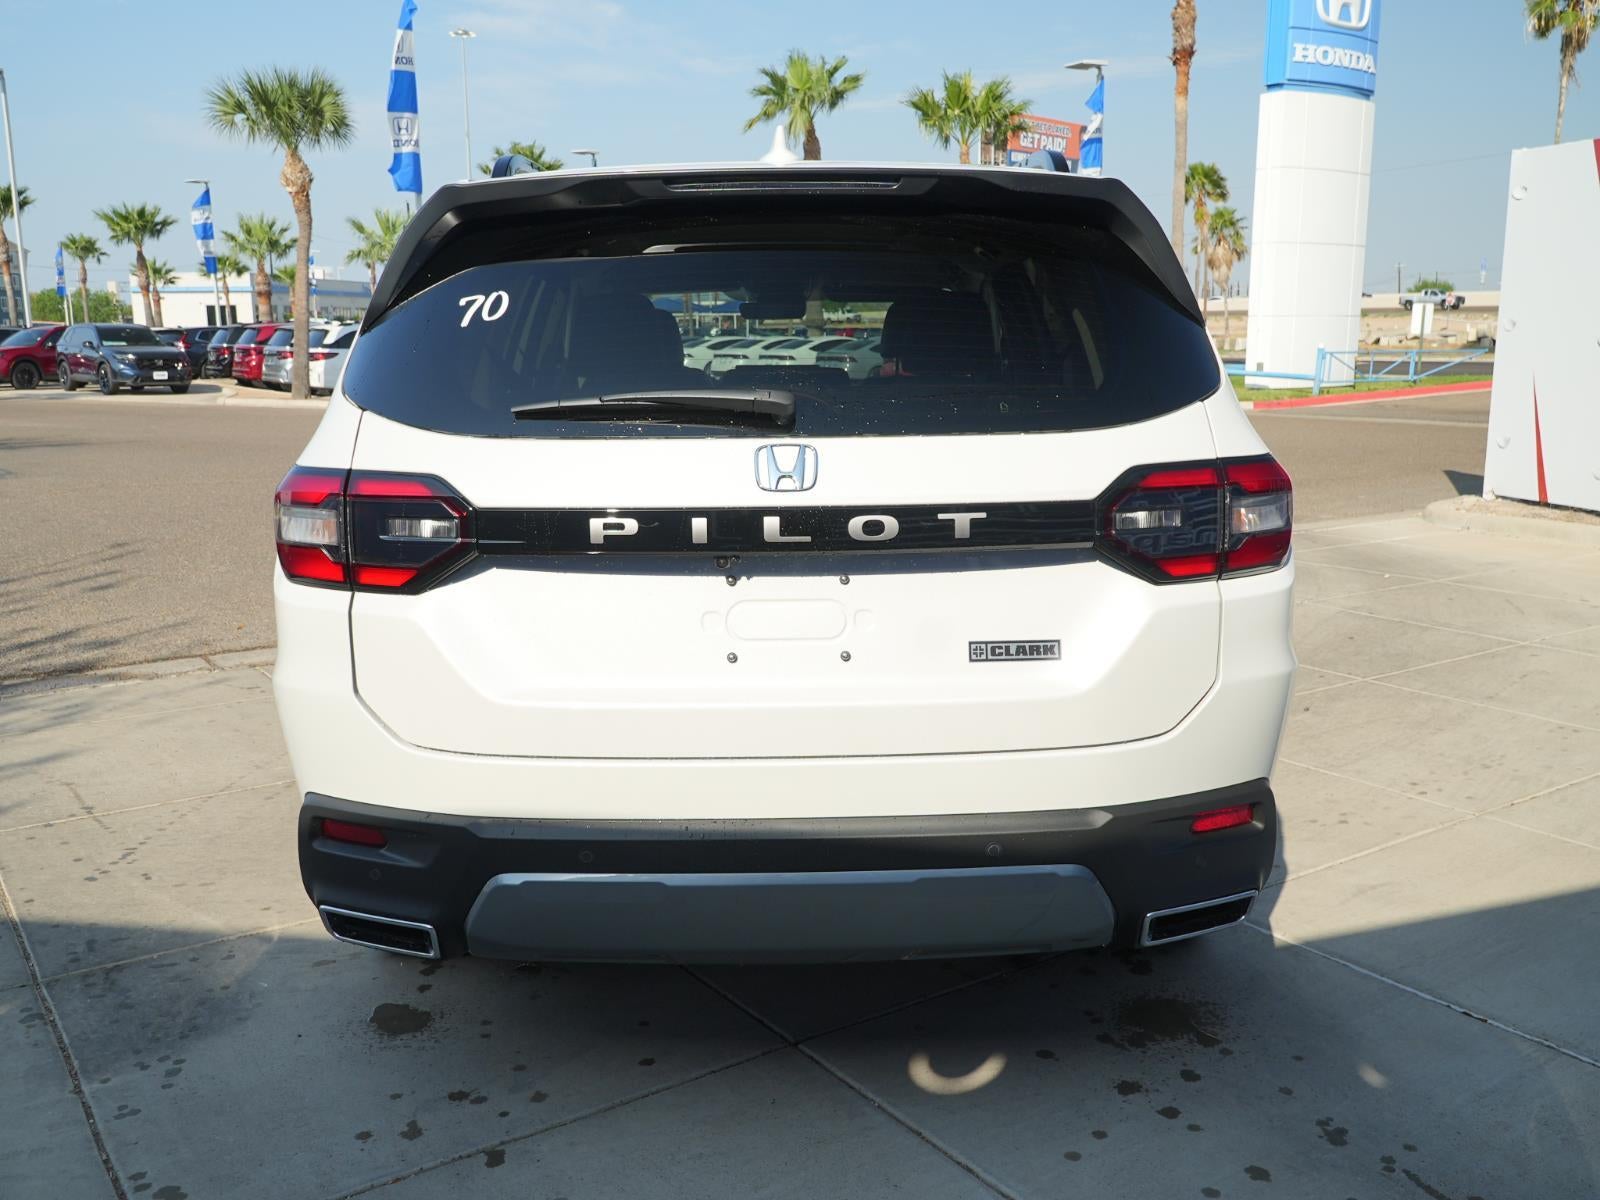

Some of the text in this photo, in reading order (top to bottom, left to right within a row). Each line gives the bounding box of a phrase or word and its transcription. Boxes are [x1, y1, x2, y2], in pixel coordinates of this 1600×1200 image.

[1292, 43, 1377, 75] HONDA
[1020, 131, 1067, 153] GET PAID!
[459, 290, 510, 328] 70
[589, 512, 987, 545] PILOT
[990, 644, 1057, 657] CLARK
